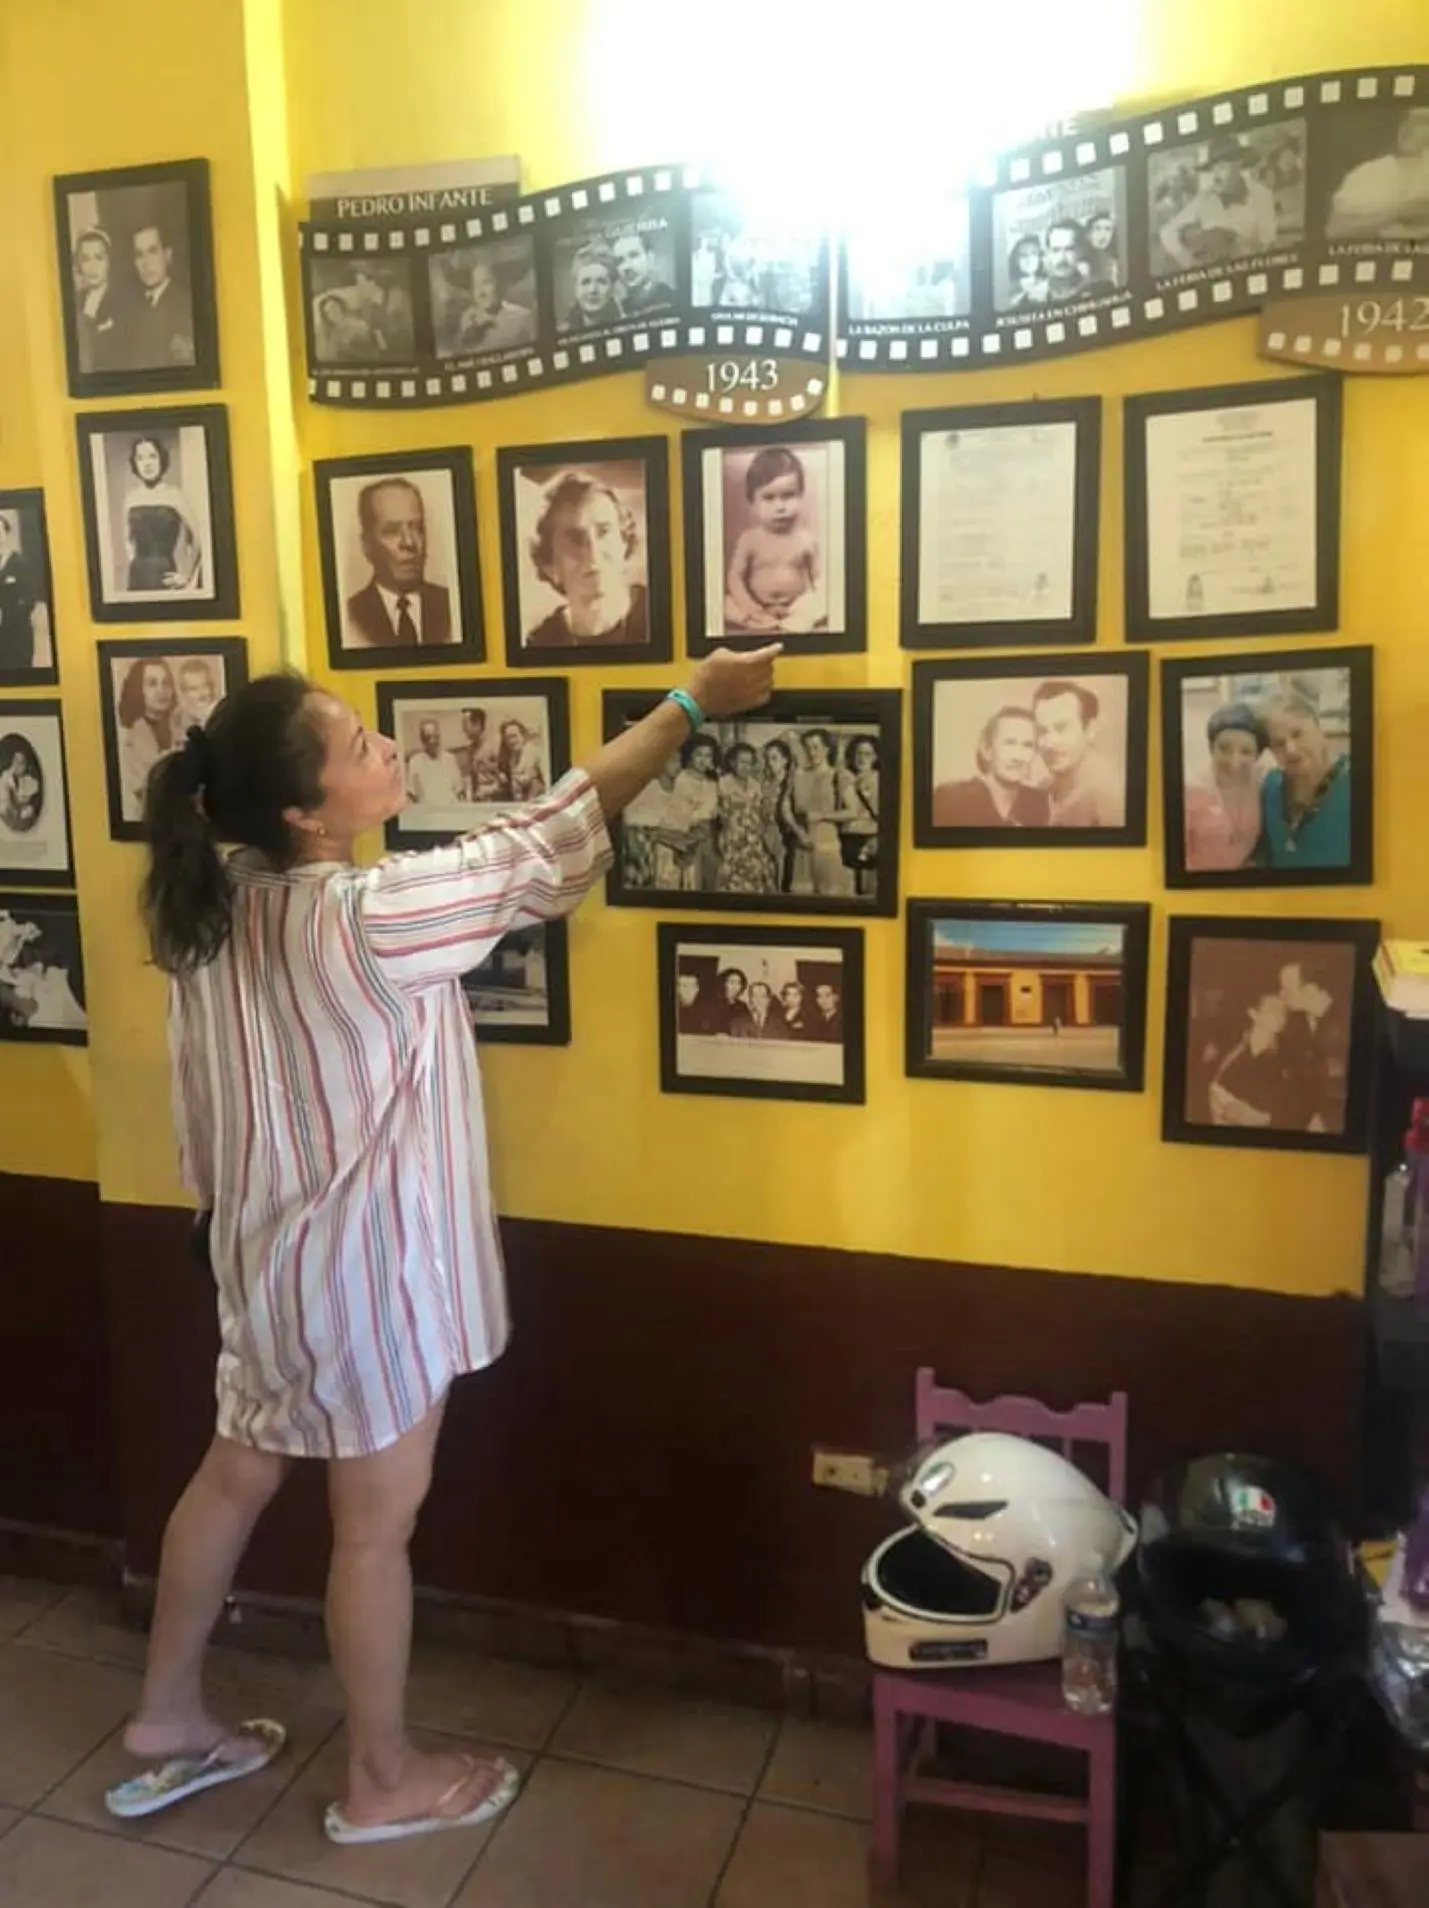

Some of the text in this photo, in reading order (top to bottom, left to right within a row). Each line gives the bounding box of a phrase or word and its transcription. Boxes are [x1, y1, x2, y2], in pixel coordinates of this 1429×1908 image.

[337, 188, 493, 219] PEDRO INFANTE
[1341, 297, 1429, 338] 1942
[707, 358, 780, 394] 1943
